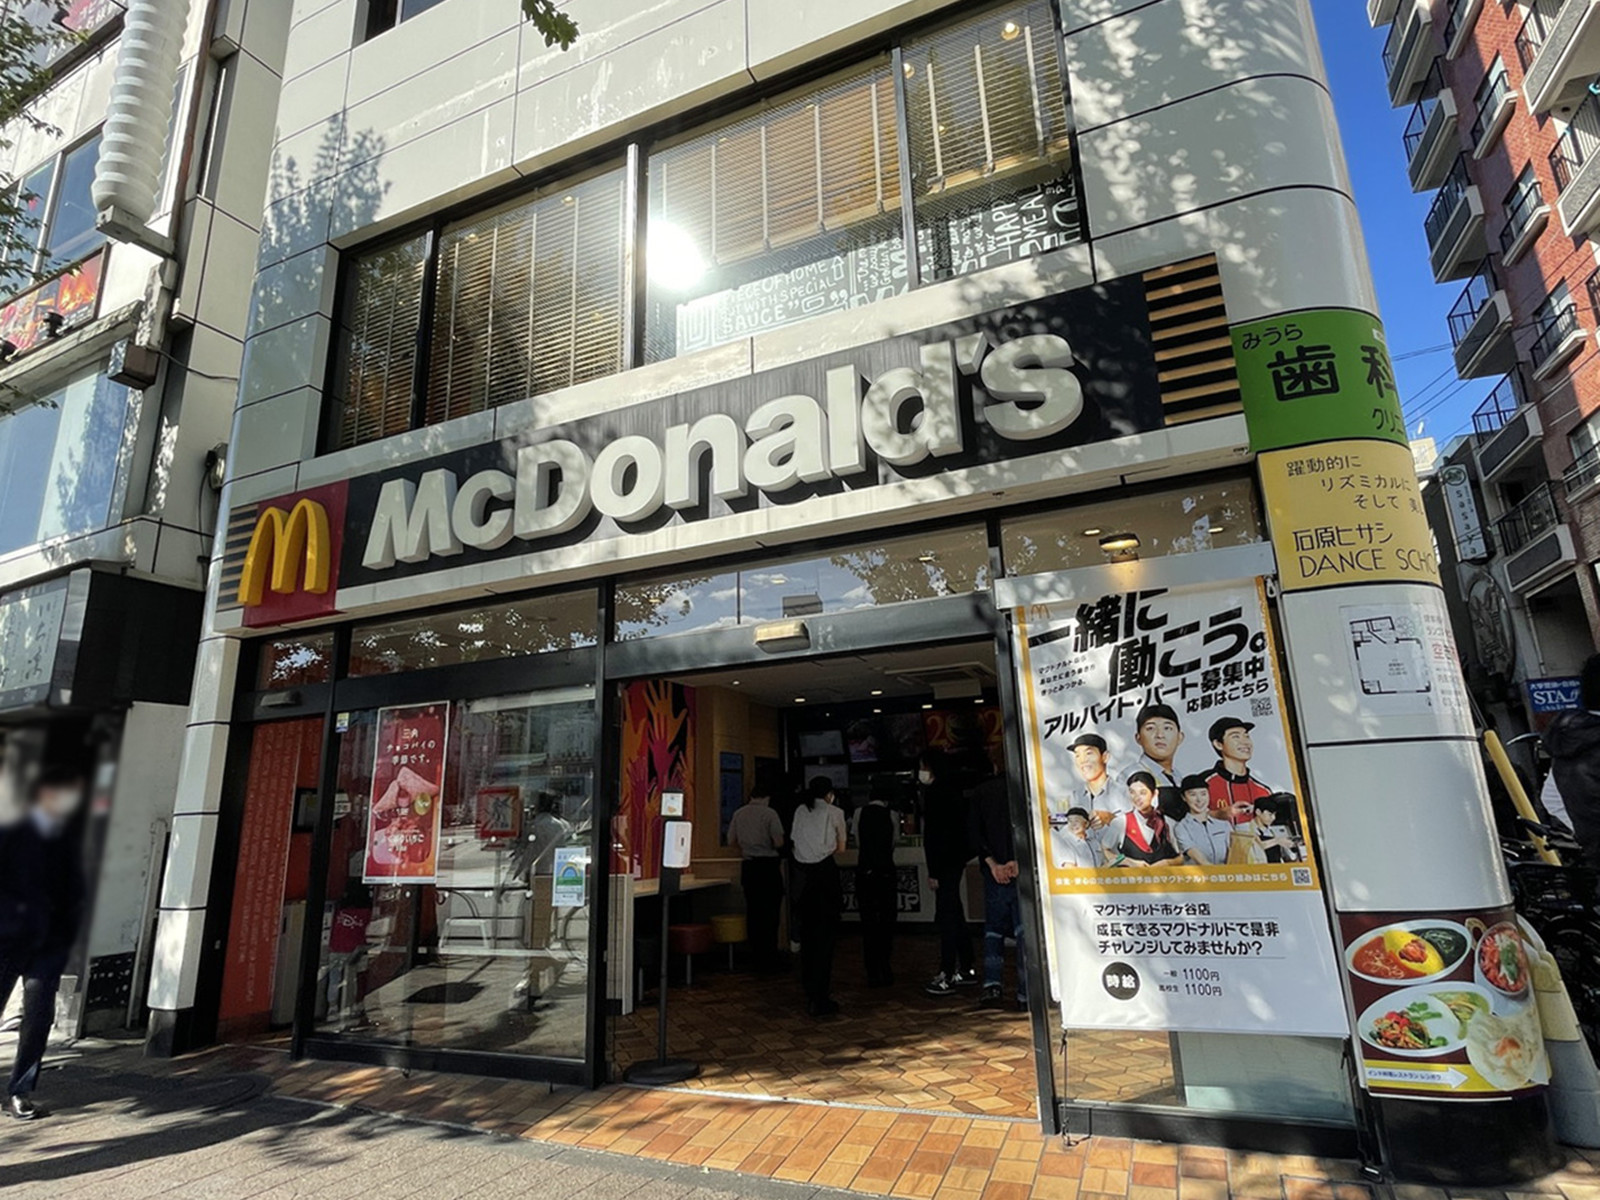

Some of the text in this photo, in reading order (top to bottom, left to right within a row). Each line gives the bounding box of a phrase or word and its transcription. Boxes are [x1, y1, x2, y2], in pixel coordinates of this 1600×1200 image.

[785, 260, 828, 284] HOME
[1241, 323, 1303, 350] みうら
[361, 332, 1084, 571] McDonald's
[1286, 455, 1361, 477] 躍動的に
[1321, 474, 1411, 492] リズミカルに
[1354, 494, 1399, 509] そして
[1292, 522, 1393, 552] 石原ヒサシ
[1299, 549, 1387, 579] DANCE
[1028, 587, 1169, 653] 一緒に
[1107, 606, 1267, 697] 働こう。
[1186, 677, 1270, 714] 応募はこちら
[1097, 921, 1280, 938] 成長できるマクドナルドで是非
[1105, 973, 1136, 988] 時給
[1182, 968, 1220, 981] 1100円
[1185, 983, 1222, 996] 1100円
